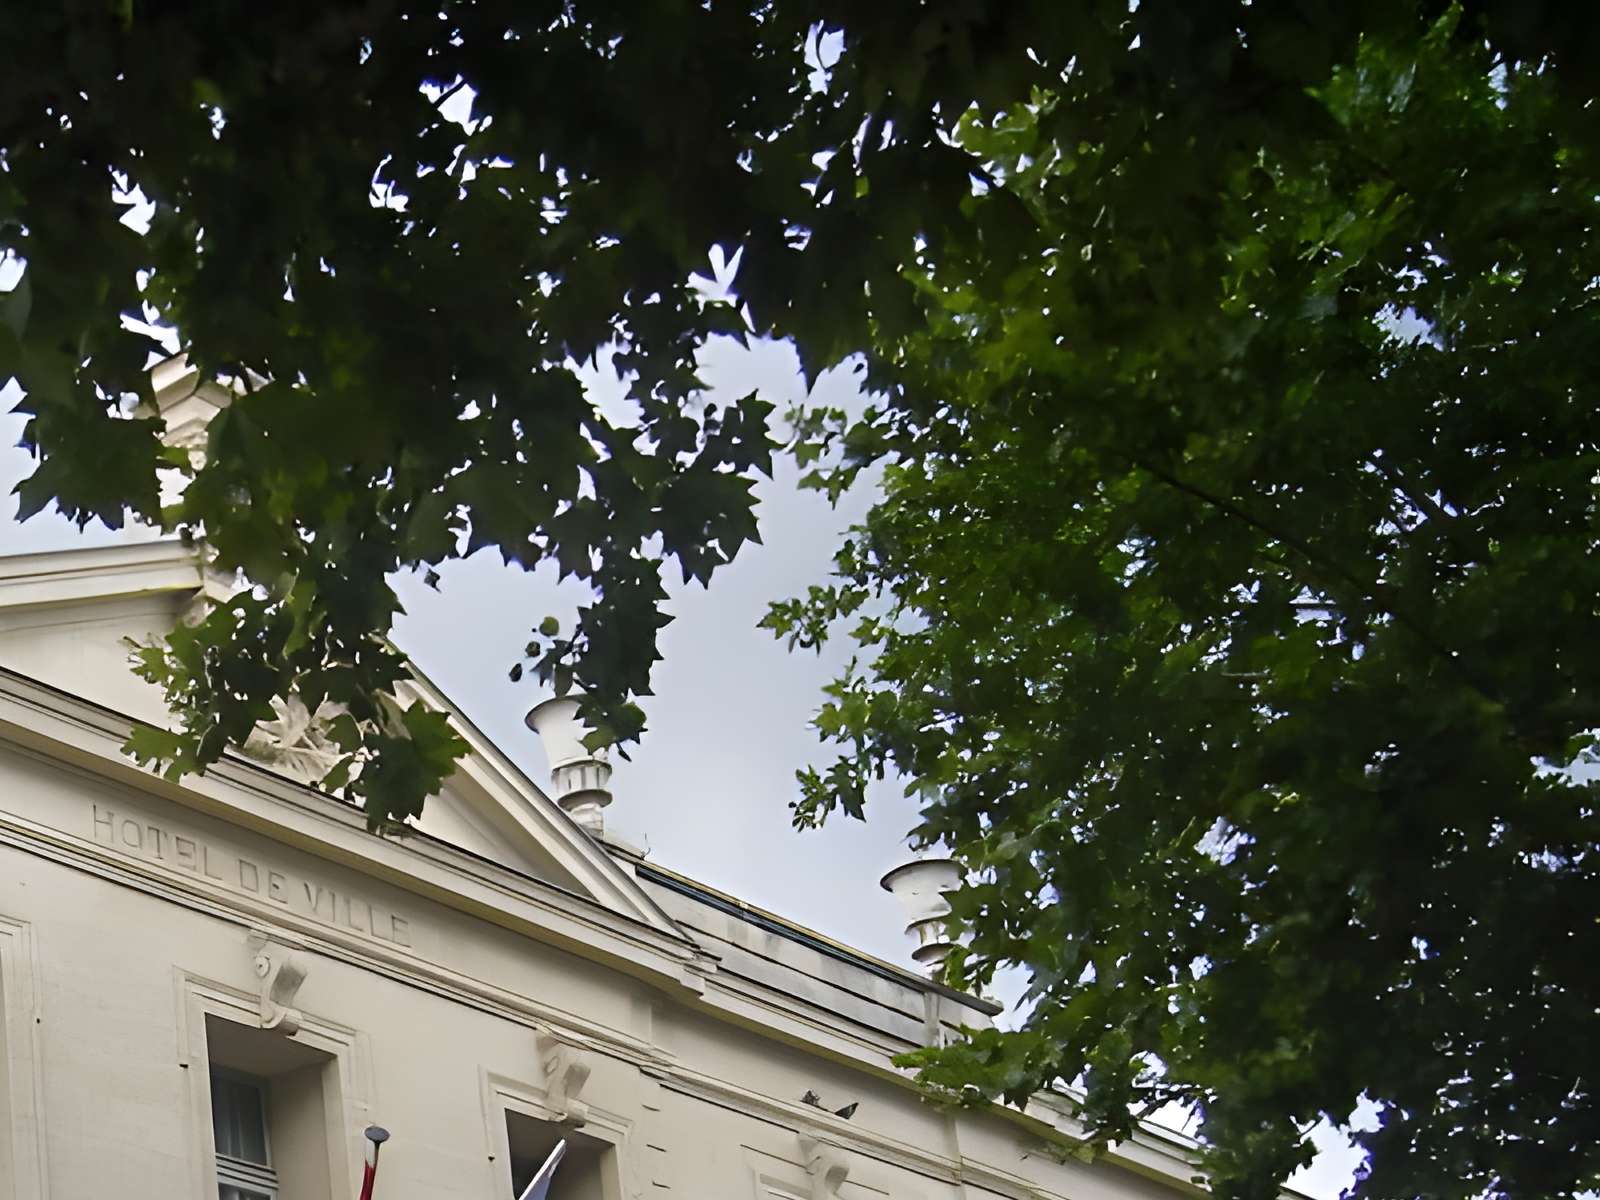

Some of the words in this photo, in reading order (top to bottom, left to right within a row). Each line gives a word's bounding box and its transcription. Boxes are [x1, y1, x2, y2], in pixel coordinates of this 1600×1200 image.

[93, 803, 223, 880] HOTEL
[239, 858, 288, 904] DE
[303, 881, 412, 948] VILLE
